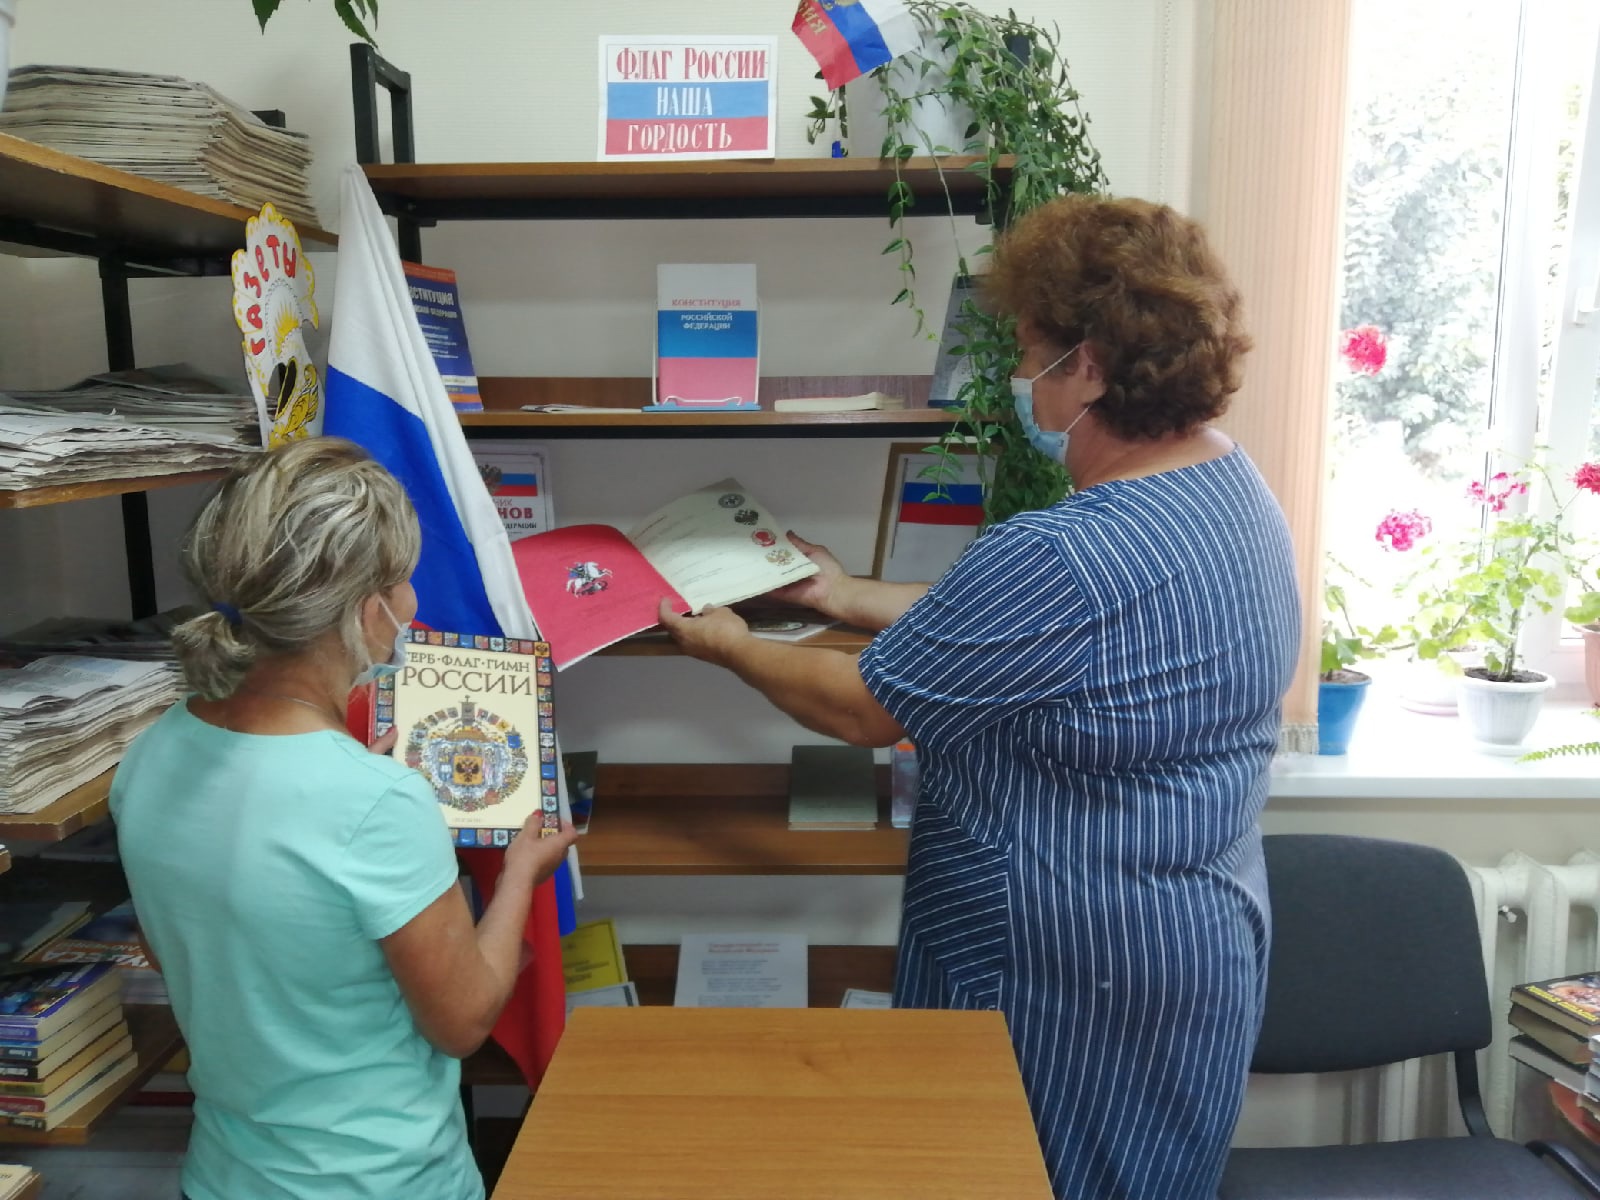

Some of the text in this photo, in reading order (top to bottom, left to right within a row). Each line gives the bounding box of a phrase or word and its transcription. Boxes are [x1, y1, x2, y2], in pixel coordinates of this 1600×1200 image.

[616, 48, 672, 80] ФЛАГ
[656, 87, 712, 116] НАША
[627, 122, 733, 152] ГОРДОСТЬ
[672, 299, 741, 308] КОНСТИТУЦИЯ
[680, 312, 732, 321] РОССИЙСКОЙ
[683, 322, 731, 331] ФЕДЕРАЦИИ
[401, 665, 533, 696] РОССИИ
